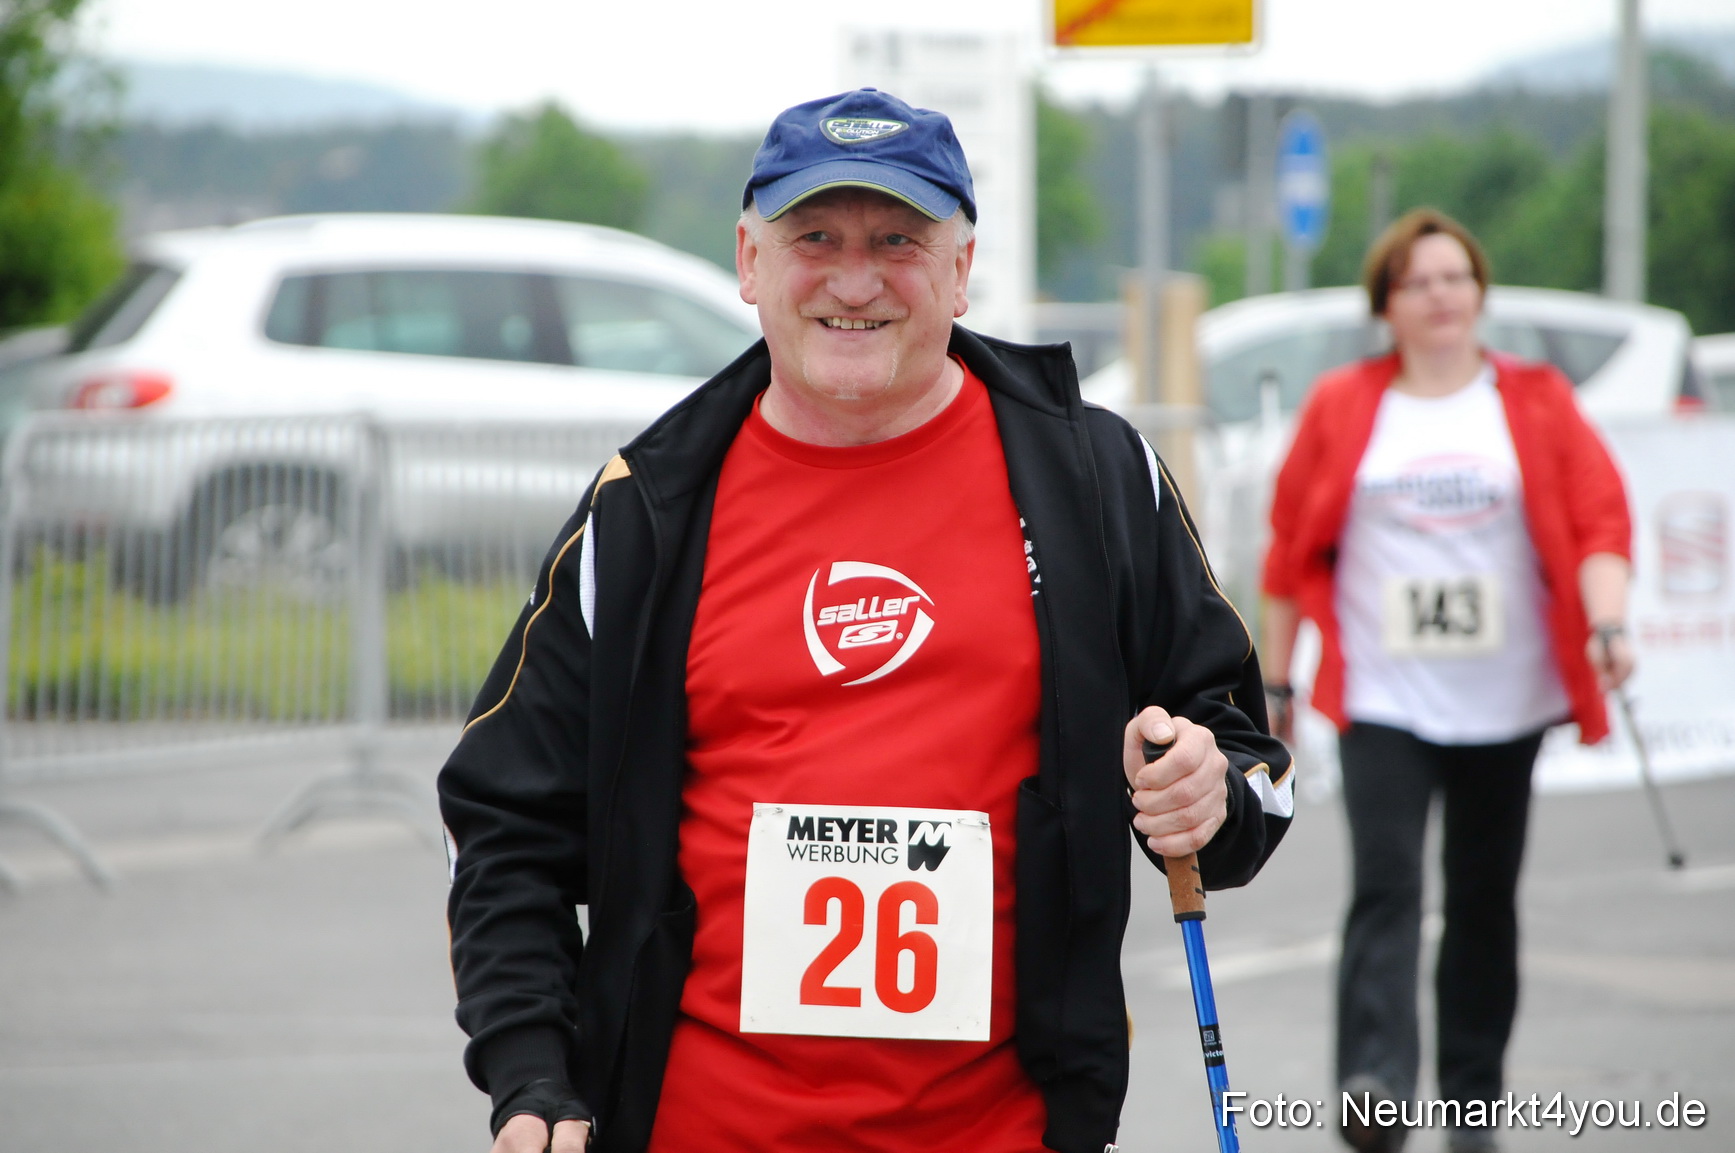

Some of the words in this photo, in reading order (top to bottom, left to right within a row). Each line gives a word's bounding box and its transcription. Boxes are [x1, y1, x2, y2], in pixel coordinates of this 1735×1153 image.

[817, 596, 920, 626] saller
[1408, 580, 1481, 636] 143
[787, 816, 899, 844] MEYER
[787, 843, 899, 865] WERBUNG
[800, 876, 939, 1014] 26
